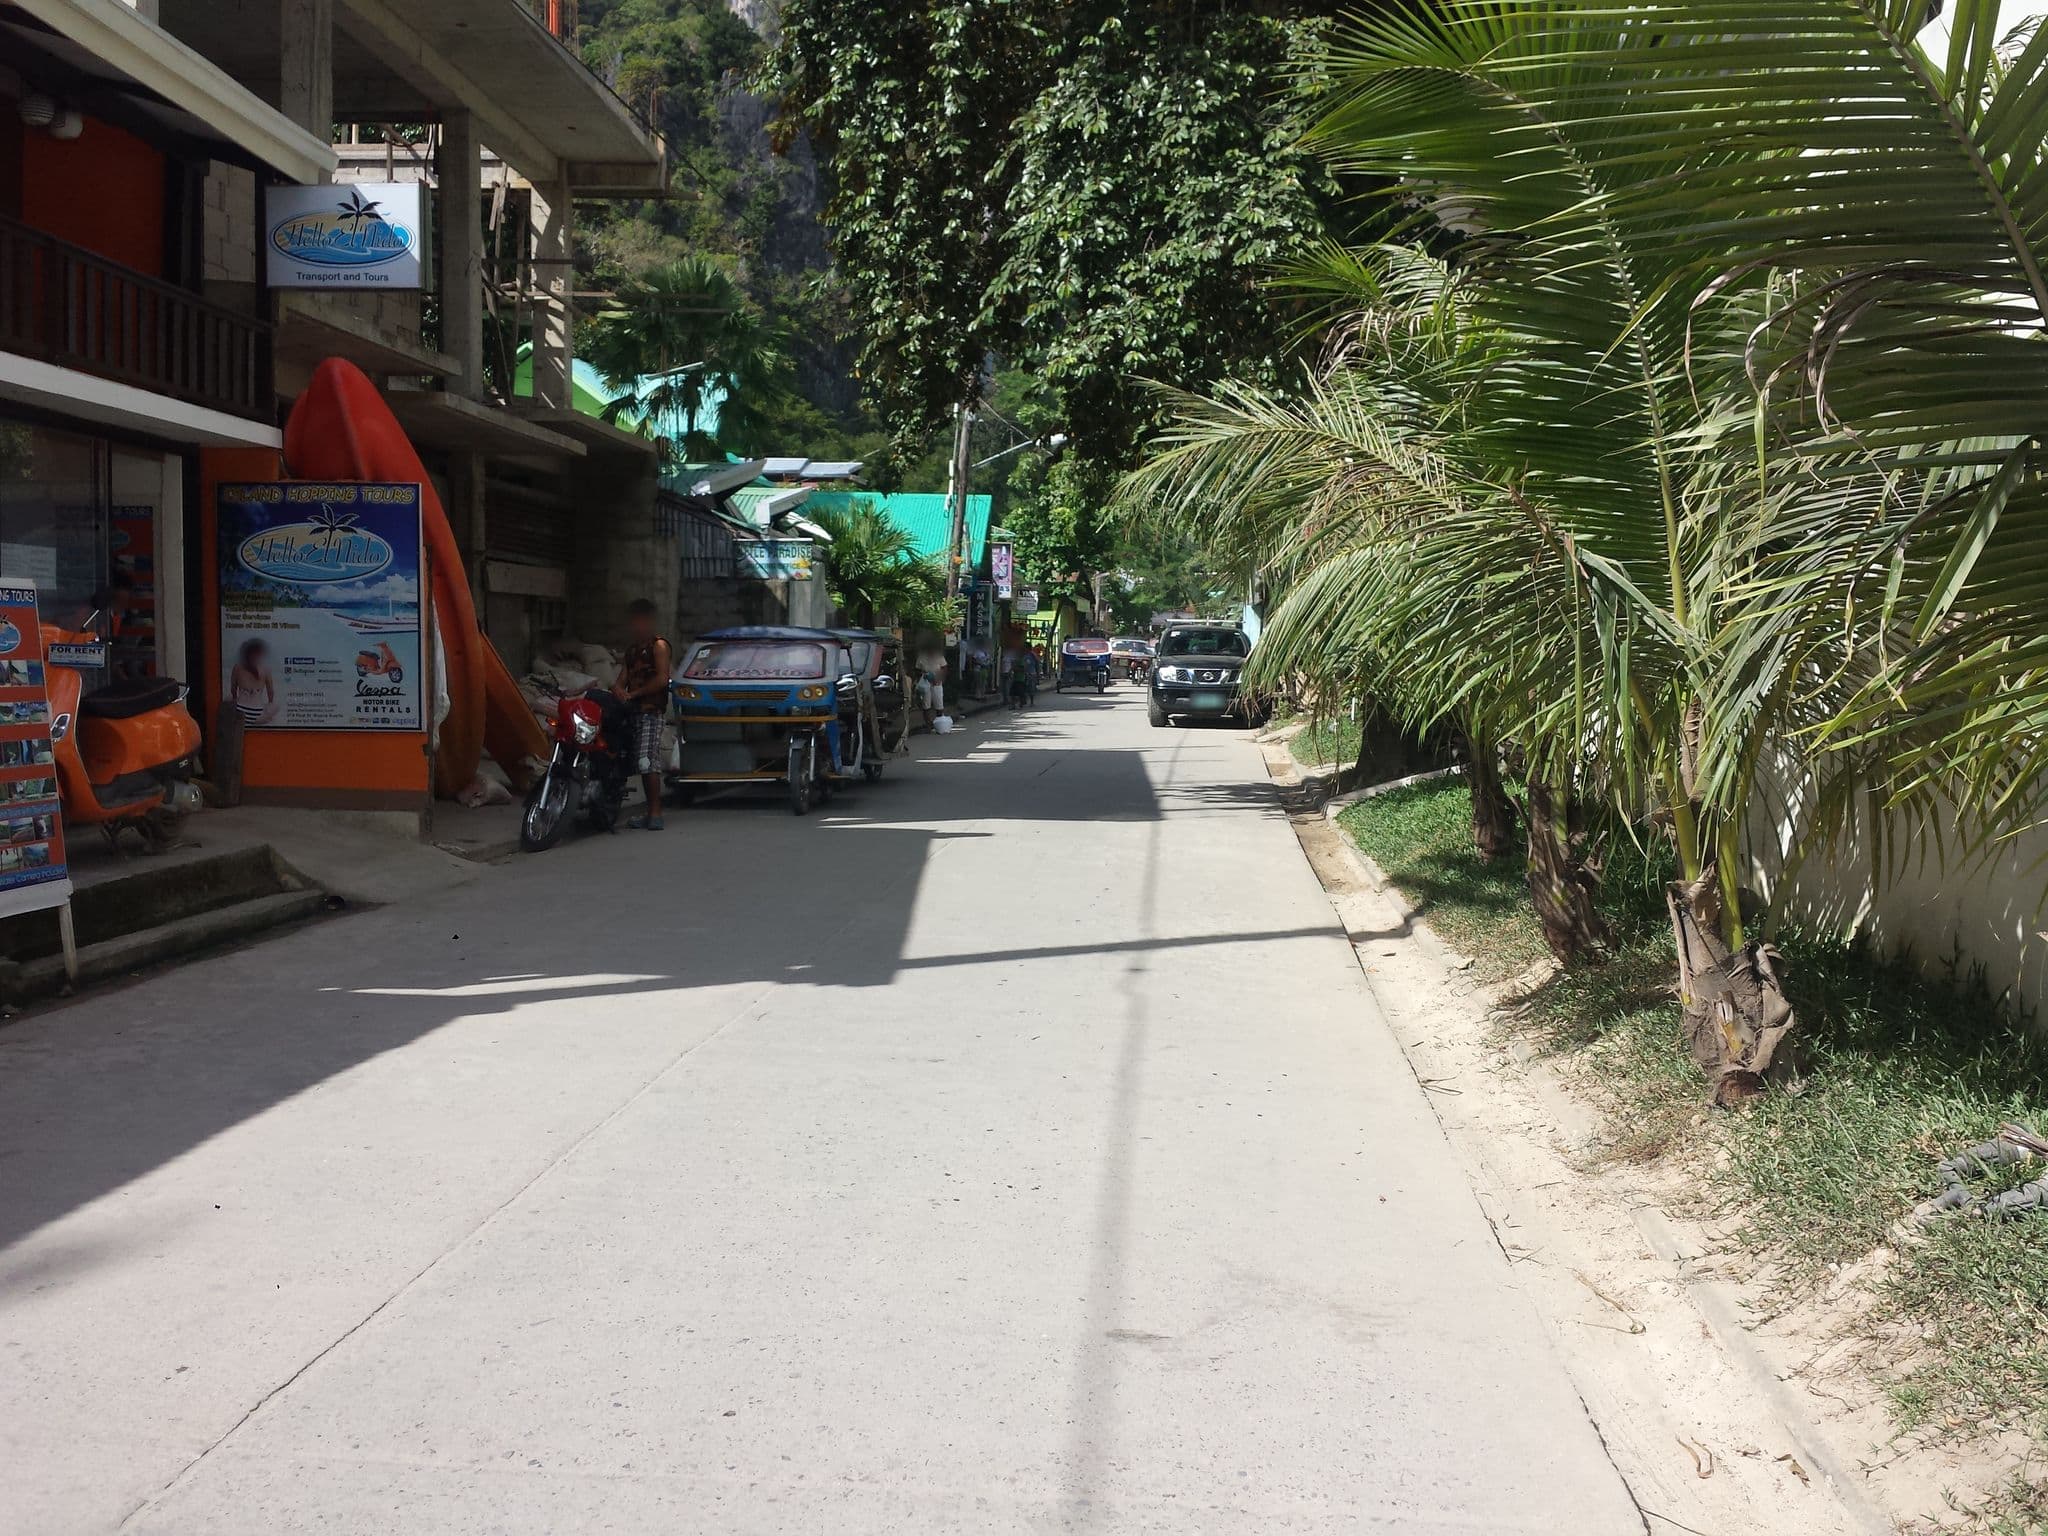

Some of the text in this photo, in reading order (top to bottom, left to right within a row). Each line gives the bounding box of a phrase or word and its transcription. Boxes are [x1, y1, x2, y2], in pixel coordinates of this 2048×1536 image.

[297, 272, 389, 282] Transport and Tours
[225, 486, 416, 504] LAND HOPPING TOURS
[12, 589, 34, 603] TOURS
[75, 647, 103, 655] RENT
[354, 678, 406, 697] Vespa
[356, 706, 411, 714] RENTALS
